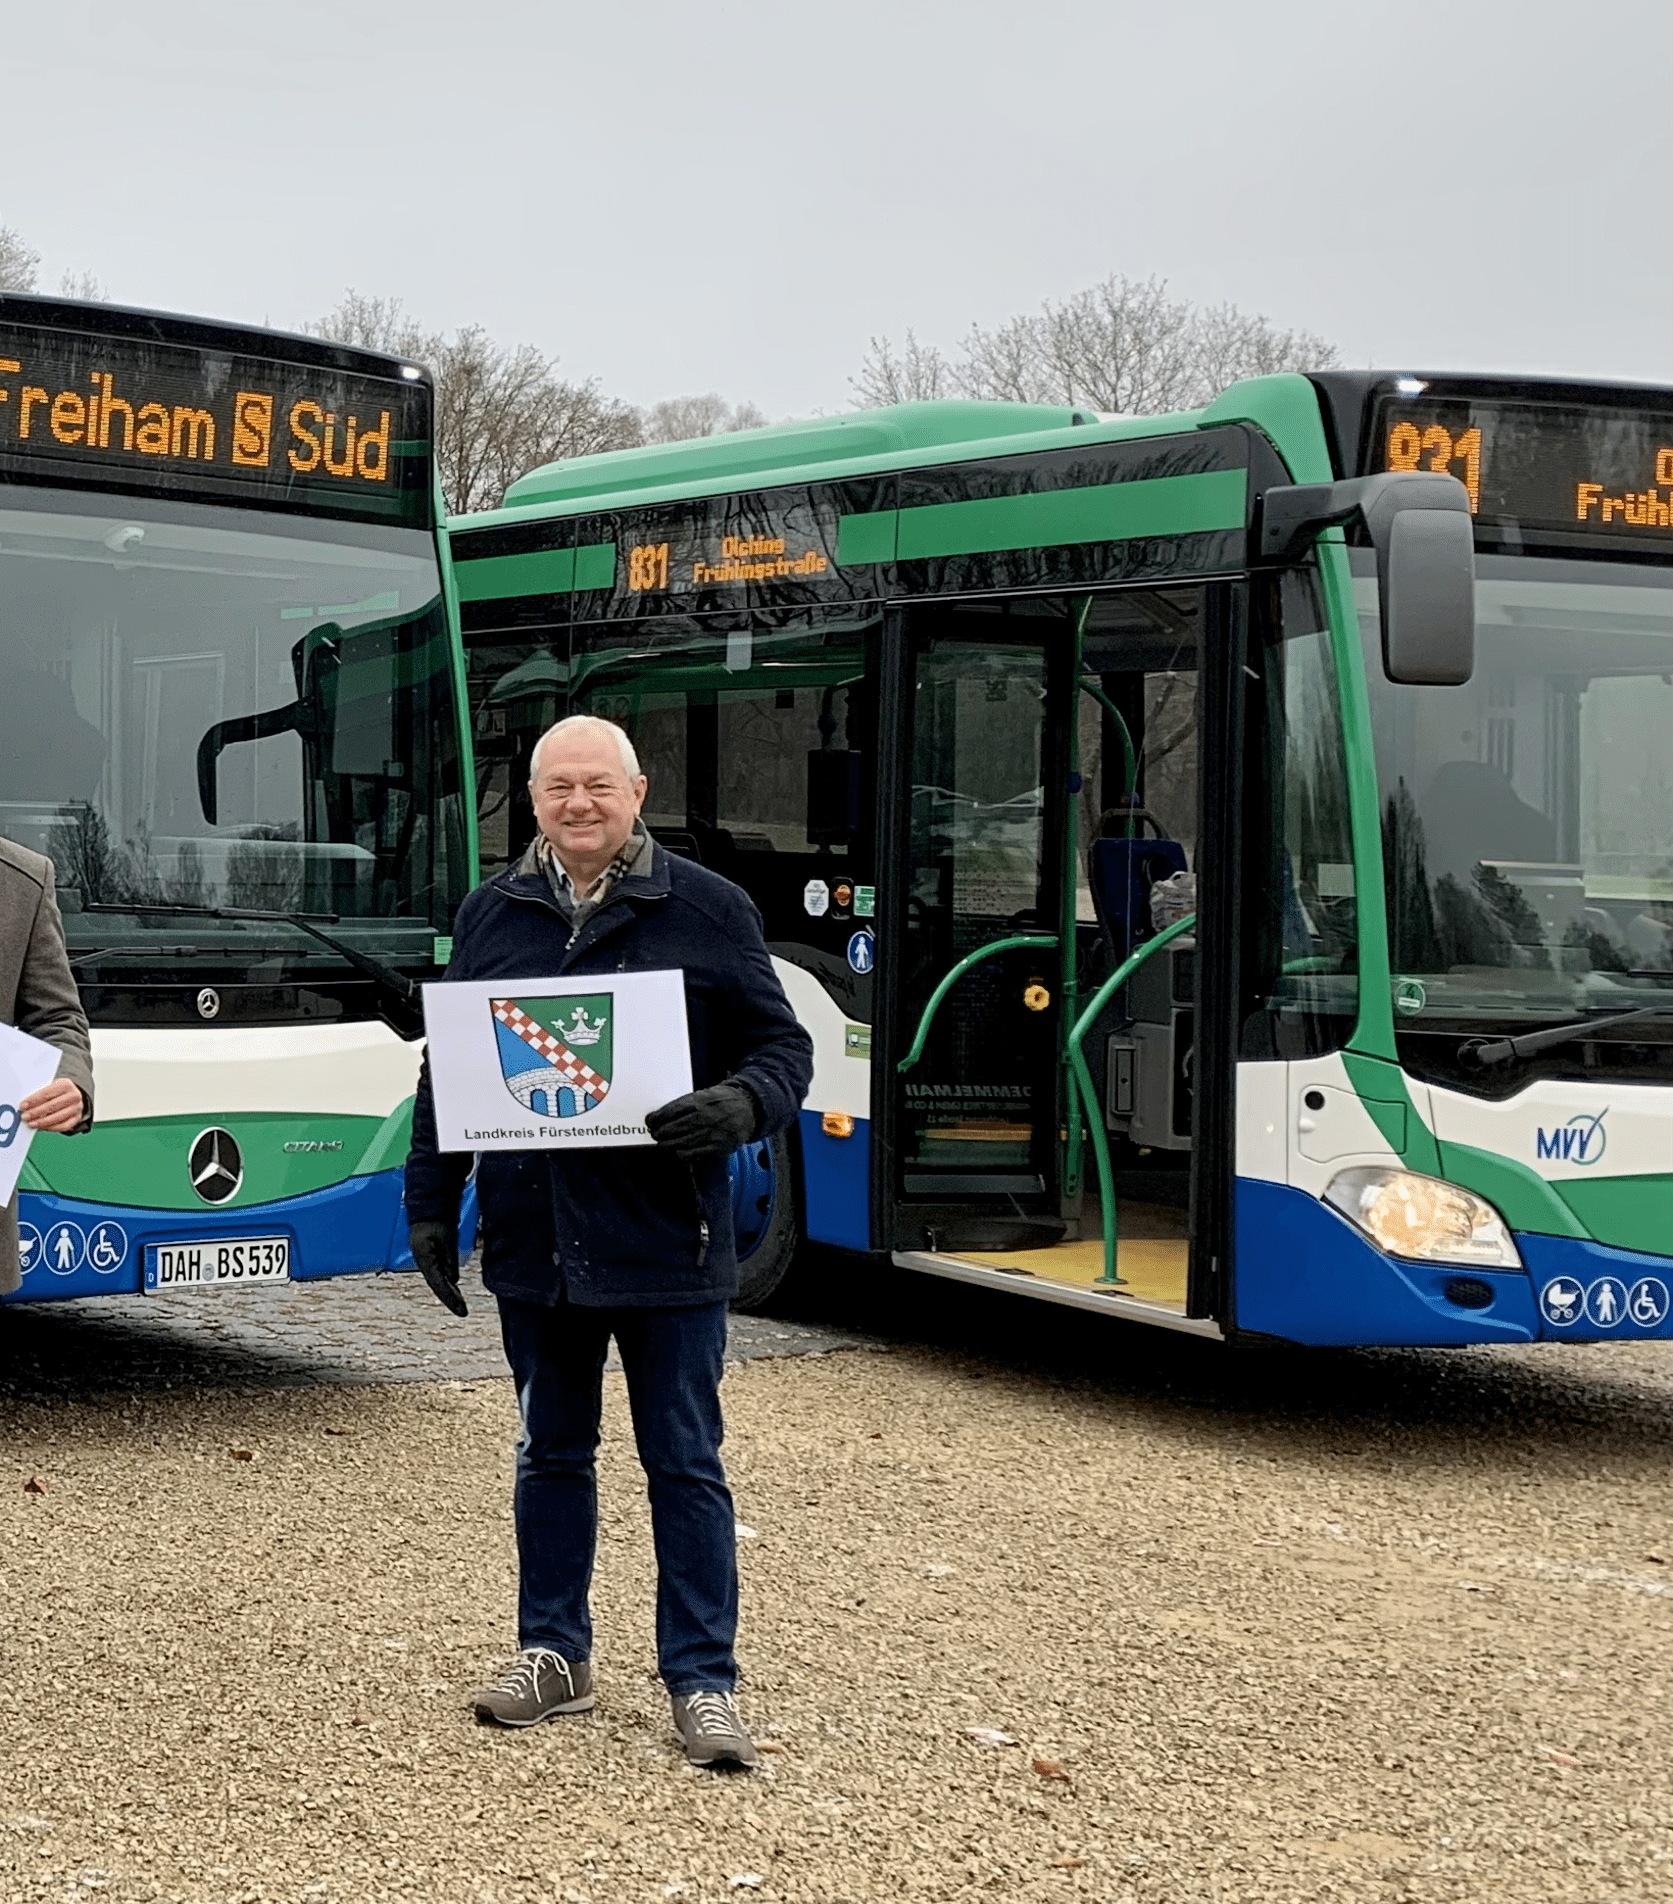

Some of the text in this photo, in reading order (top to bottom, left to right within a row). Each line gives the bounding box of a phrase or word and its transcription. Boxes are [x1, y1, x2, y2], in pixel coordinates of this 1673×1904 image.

[288, 399, 390, 481] Süd
[722, 534, 785, 558] Olching
[629, 542, 669, 591] 831
[693, 550, 827, 584] Frühlingstraße
[464, 1124, 650, 1140] Landkreis Fürstenfeldbru
[1537, 1105, 1610, 1160] MVV
[160, 1249, 201, 1283] DAH
[217, 1246, 245, 1278] BS
[248, 1243, 286, 1278] 539
